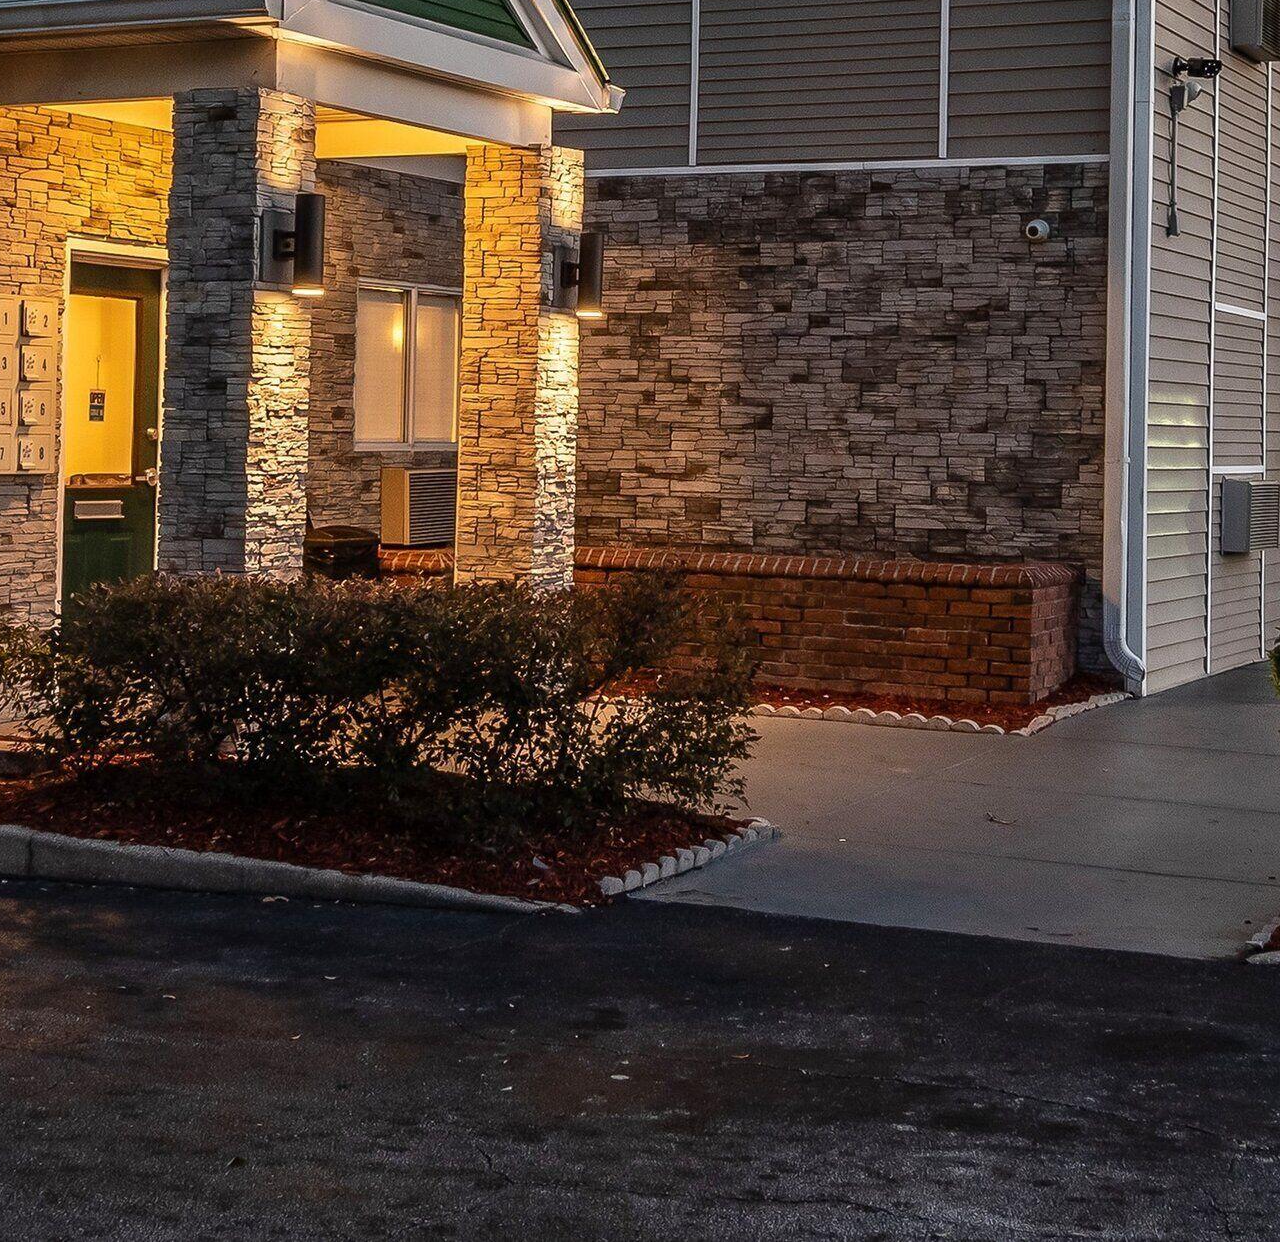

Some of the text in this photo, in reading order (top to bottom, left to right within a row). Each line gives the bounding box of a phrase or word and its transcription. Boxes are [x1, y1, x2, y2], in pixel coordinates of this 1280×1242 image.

[43, 314, 49, 328] 2
[1, 356, 7, 370] 3
[41, 358, 47, 371] 4
[0, 402, 6, 415] 5
[40, 402, 46, 416] 6
[0, 447, 5, 460] 7
[39, 446, 45, 460] 8
